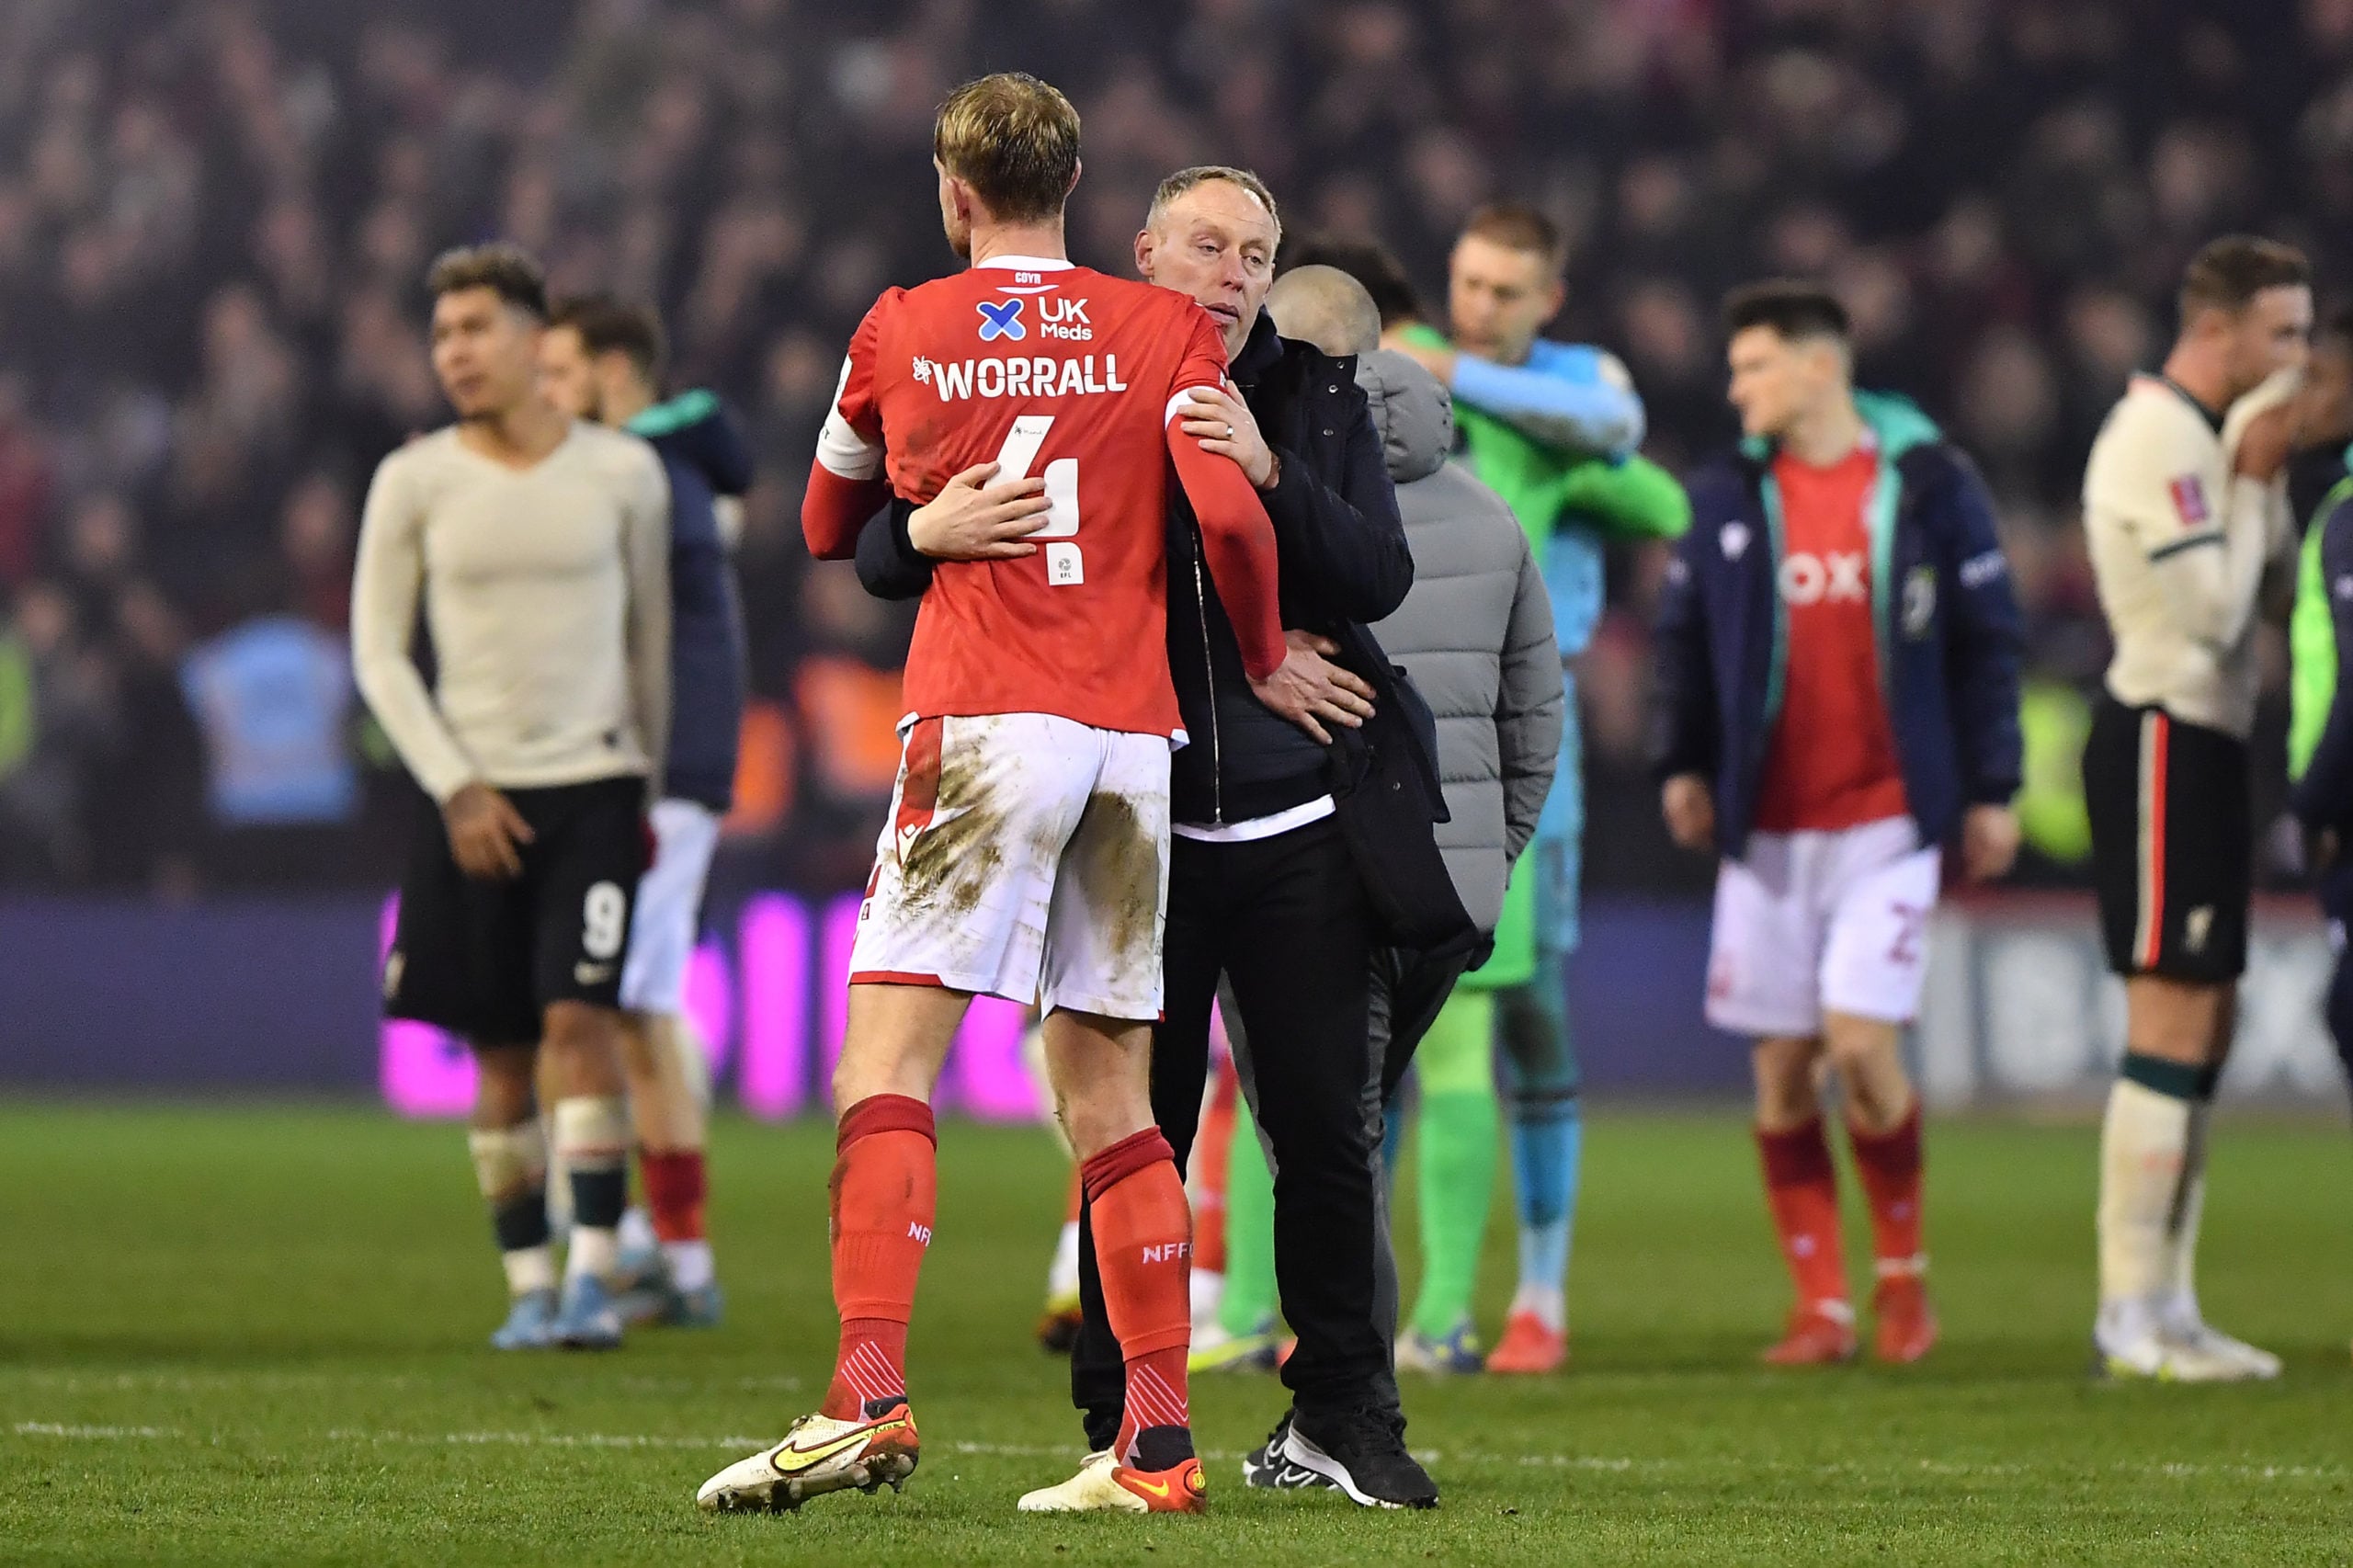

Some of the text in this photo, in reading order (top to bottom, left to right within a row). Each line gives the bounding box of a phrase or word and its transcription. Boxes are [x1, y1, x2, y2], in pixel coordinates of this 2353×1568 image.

[1038, 296, 1091, 324] UK
[1040, 323, 1093, 340] Meds
[932, 353, 1128, 402] WORRALL
[582, 880, 627, 960] 9
